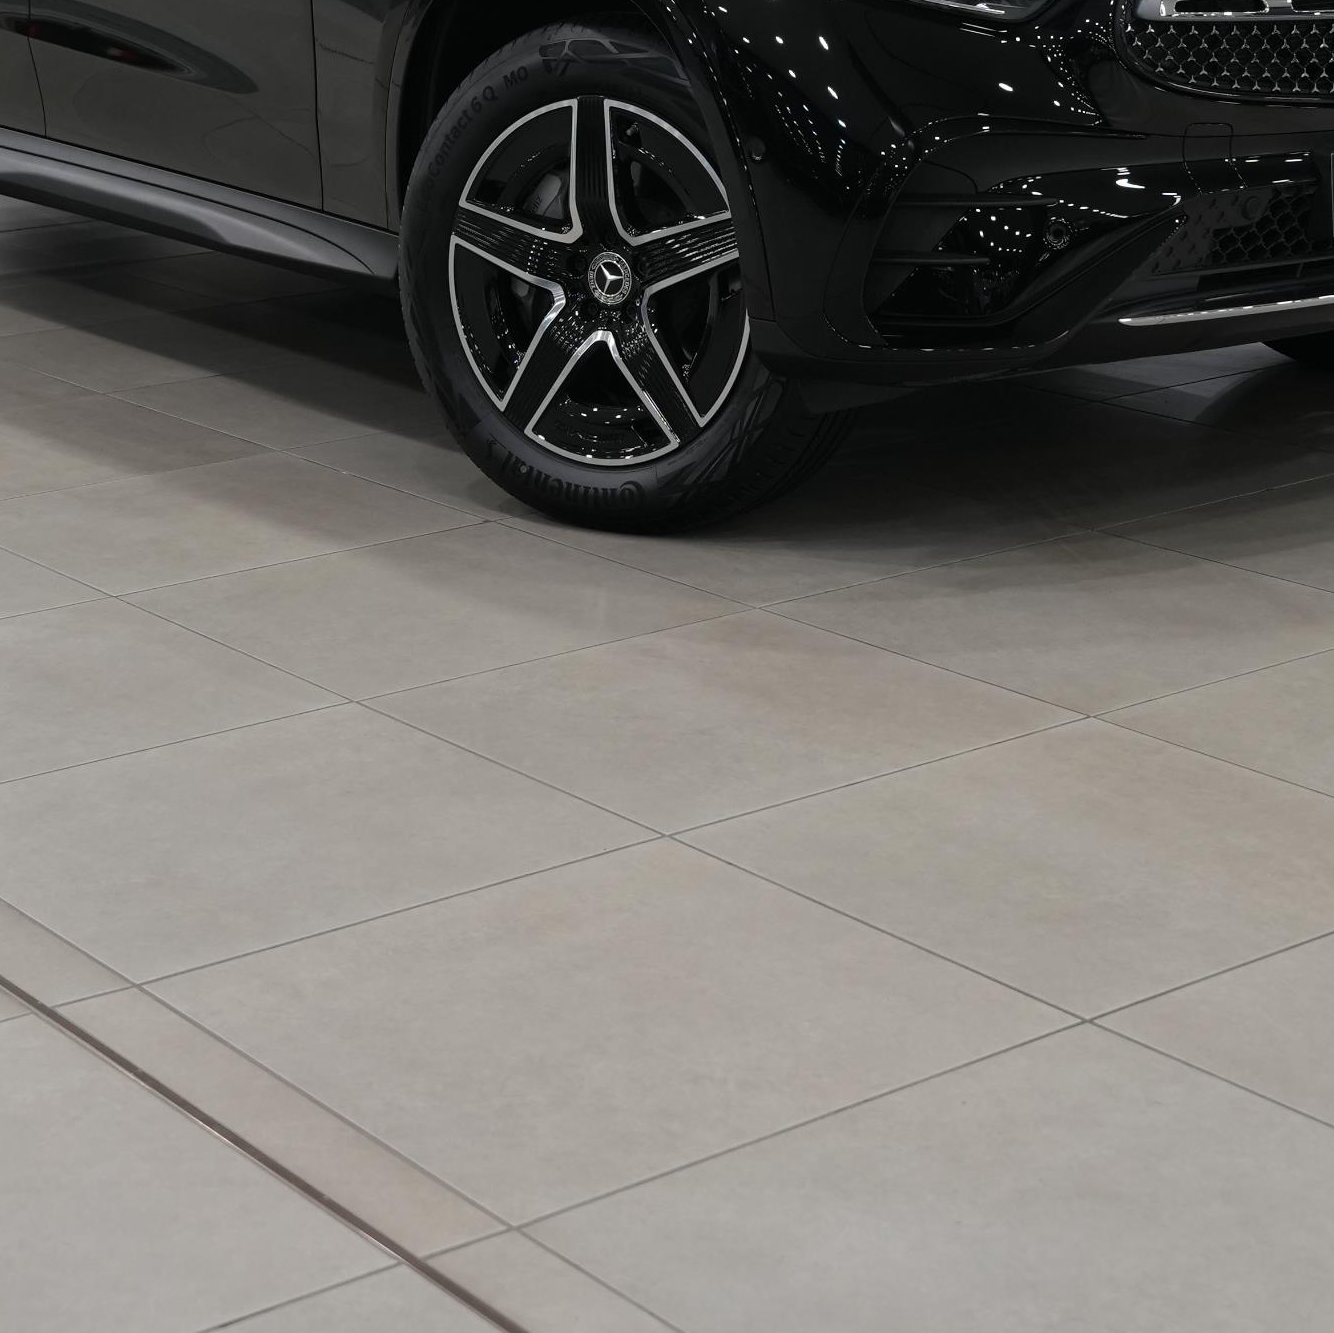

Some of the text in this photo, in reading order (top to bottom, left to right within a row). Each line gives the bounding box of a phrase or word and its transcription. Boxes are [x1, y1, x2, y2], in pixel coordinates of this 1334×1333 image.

[471, 95, 482, 113] 6
[482, 85, 498, 102] Q
[502, 66, 529, 89] MO
